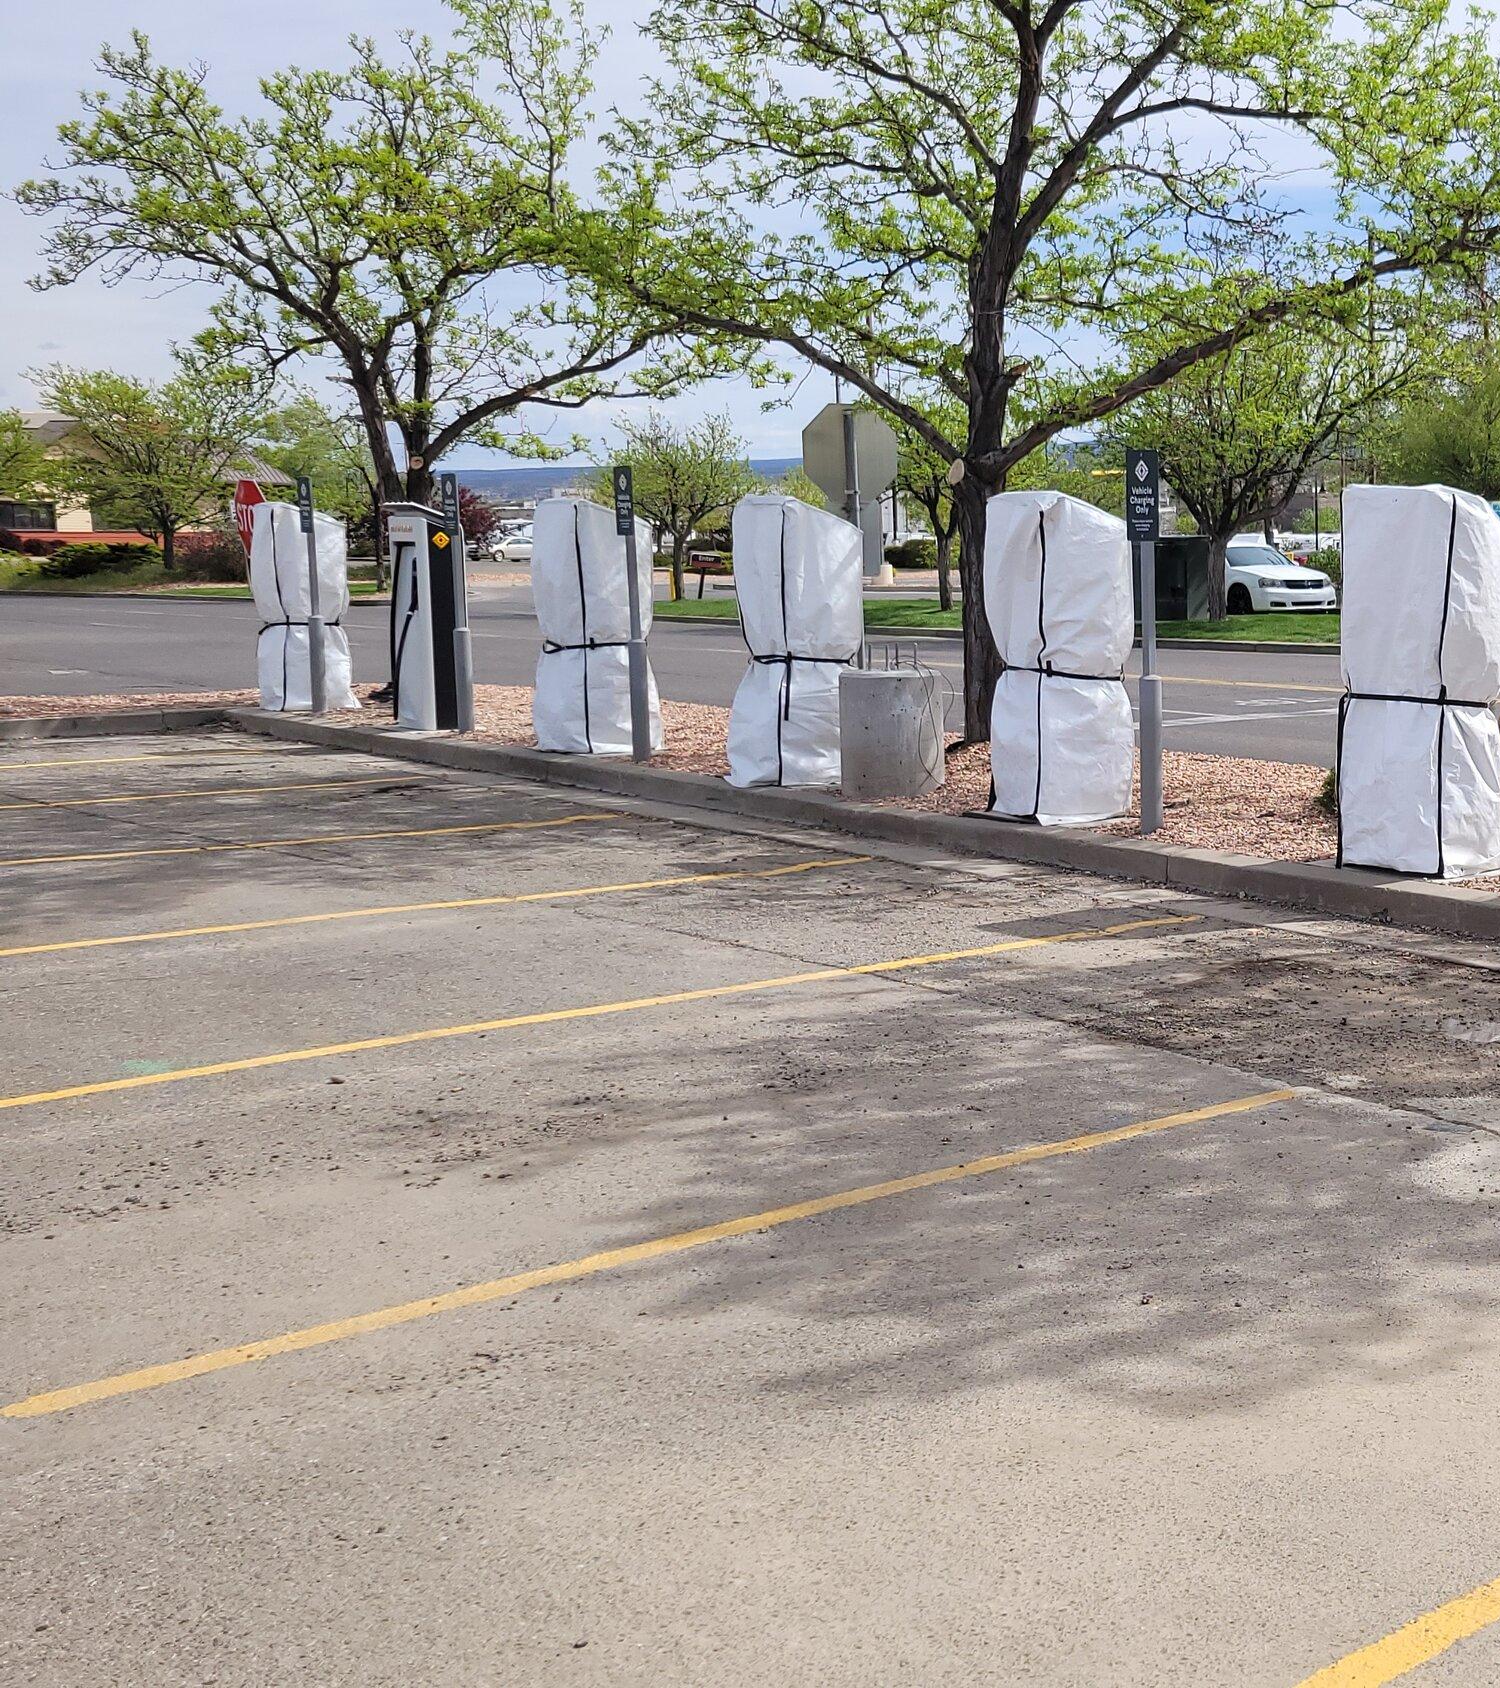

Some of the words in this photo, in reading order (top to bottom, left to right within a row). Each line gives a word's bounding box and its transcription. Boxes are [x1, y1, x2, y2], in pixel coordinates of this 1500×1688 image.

[1131, 486, 1152, 495] Vehicle
[1130, 496, 1155, 507] Charging
[1135, 505, 1149, 515] Only
[236, 502, 256, 532] STO
